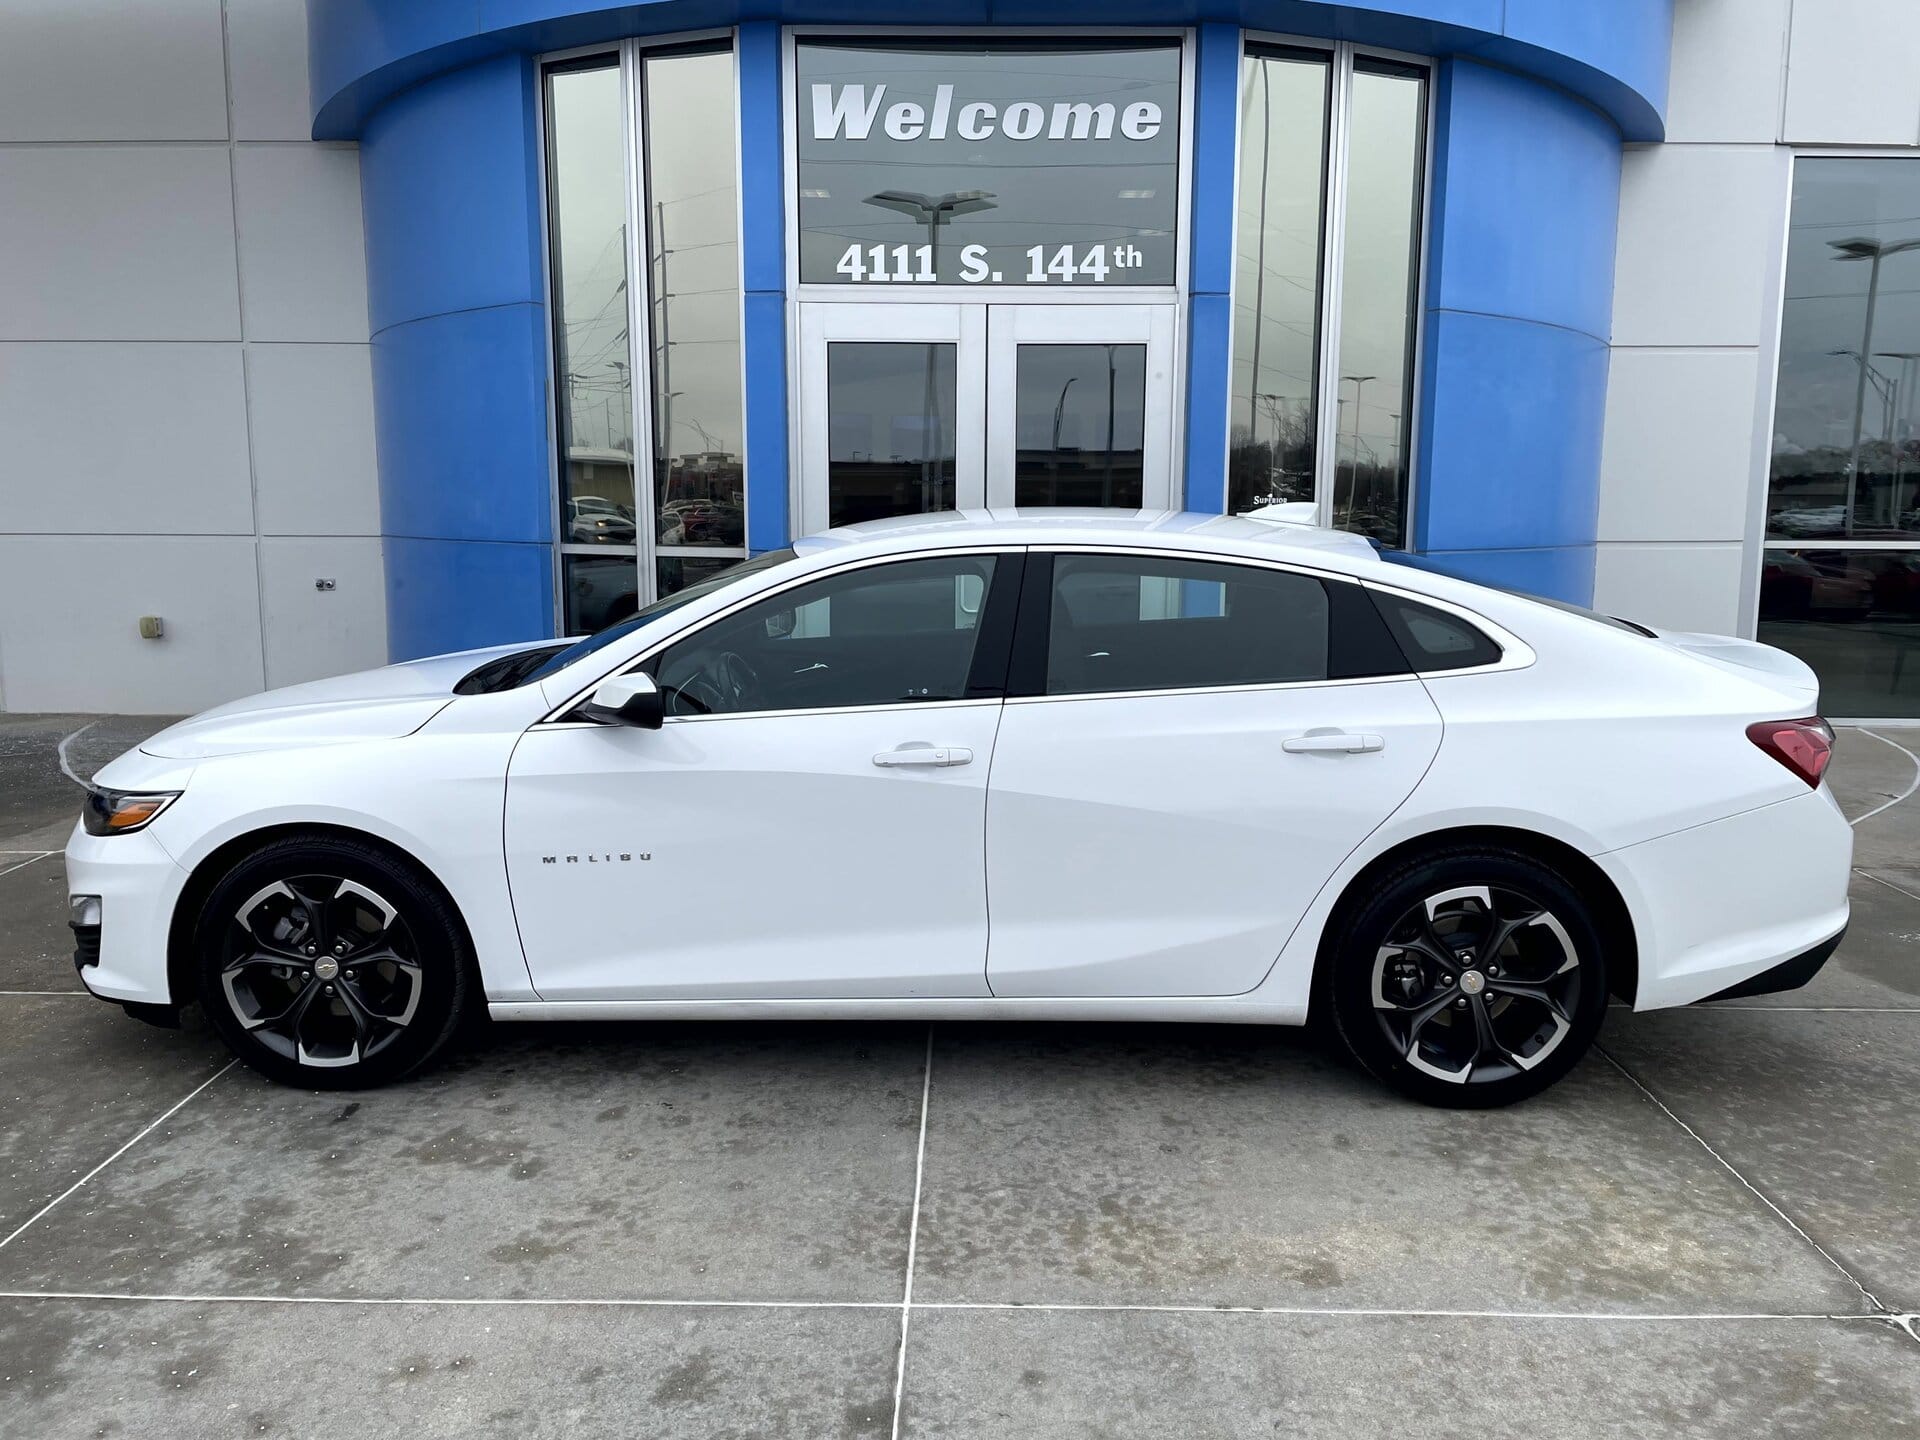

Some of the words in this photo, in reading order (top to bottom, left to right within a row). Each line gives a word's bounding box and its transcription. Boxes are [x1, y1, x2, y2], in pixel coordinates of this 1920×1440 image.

[811, 83, 1162, 141] Welcome
[836, 244, 937, 282] 4111
[958, 244, 1003, 283] S.
[541, 852, 652, 864] MALIBU
